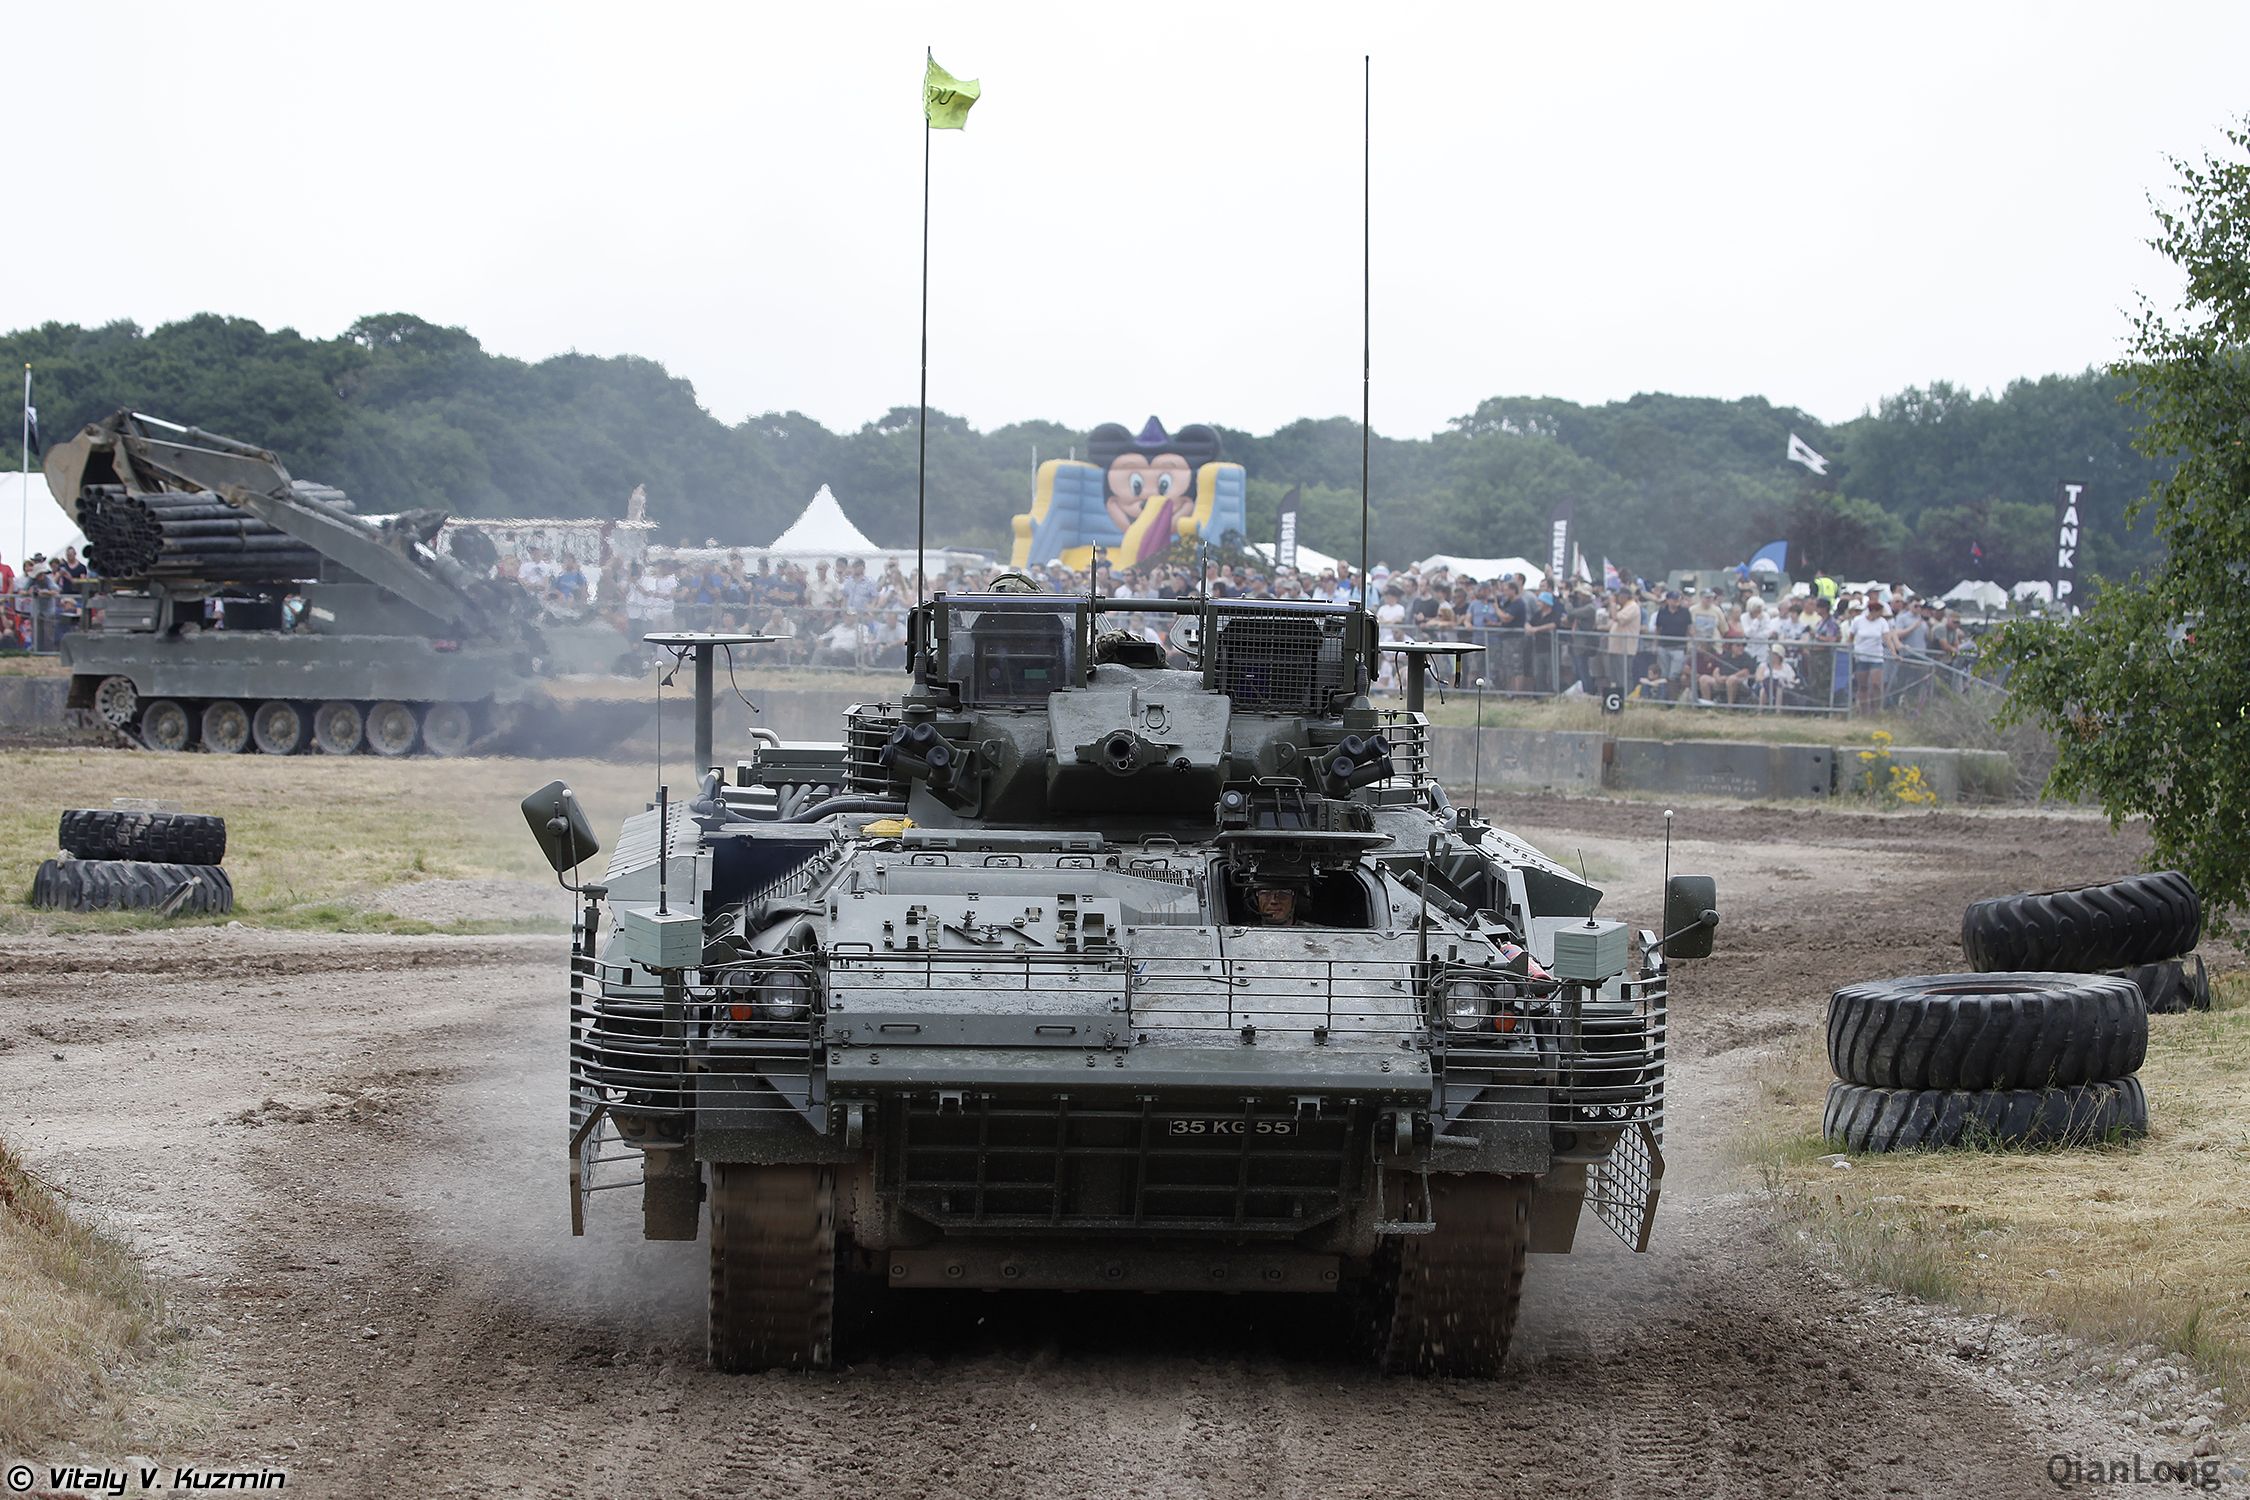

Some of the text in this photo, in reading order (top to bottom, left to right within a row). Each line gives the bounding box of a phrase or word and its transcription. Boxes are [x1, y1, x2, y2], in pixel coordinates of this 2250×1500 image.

[2058, 484, 2083, 569] TANK
[1606, 693, 1621, 710] G
[1172, 1120, 1291, 1134] 35 KG 55
